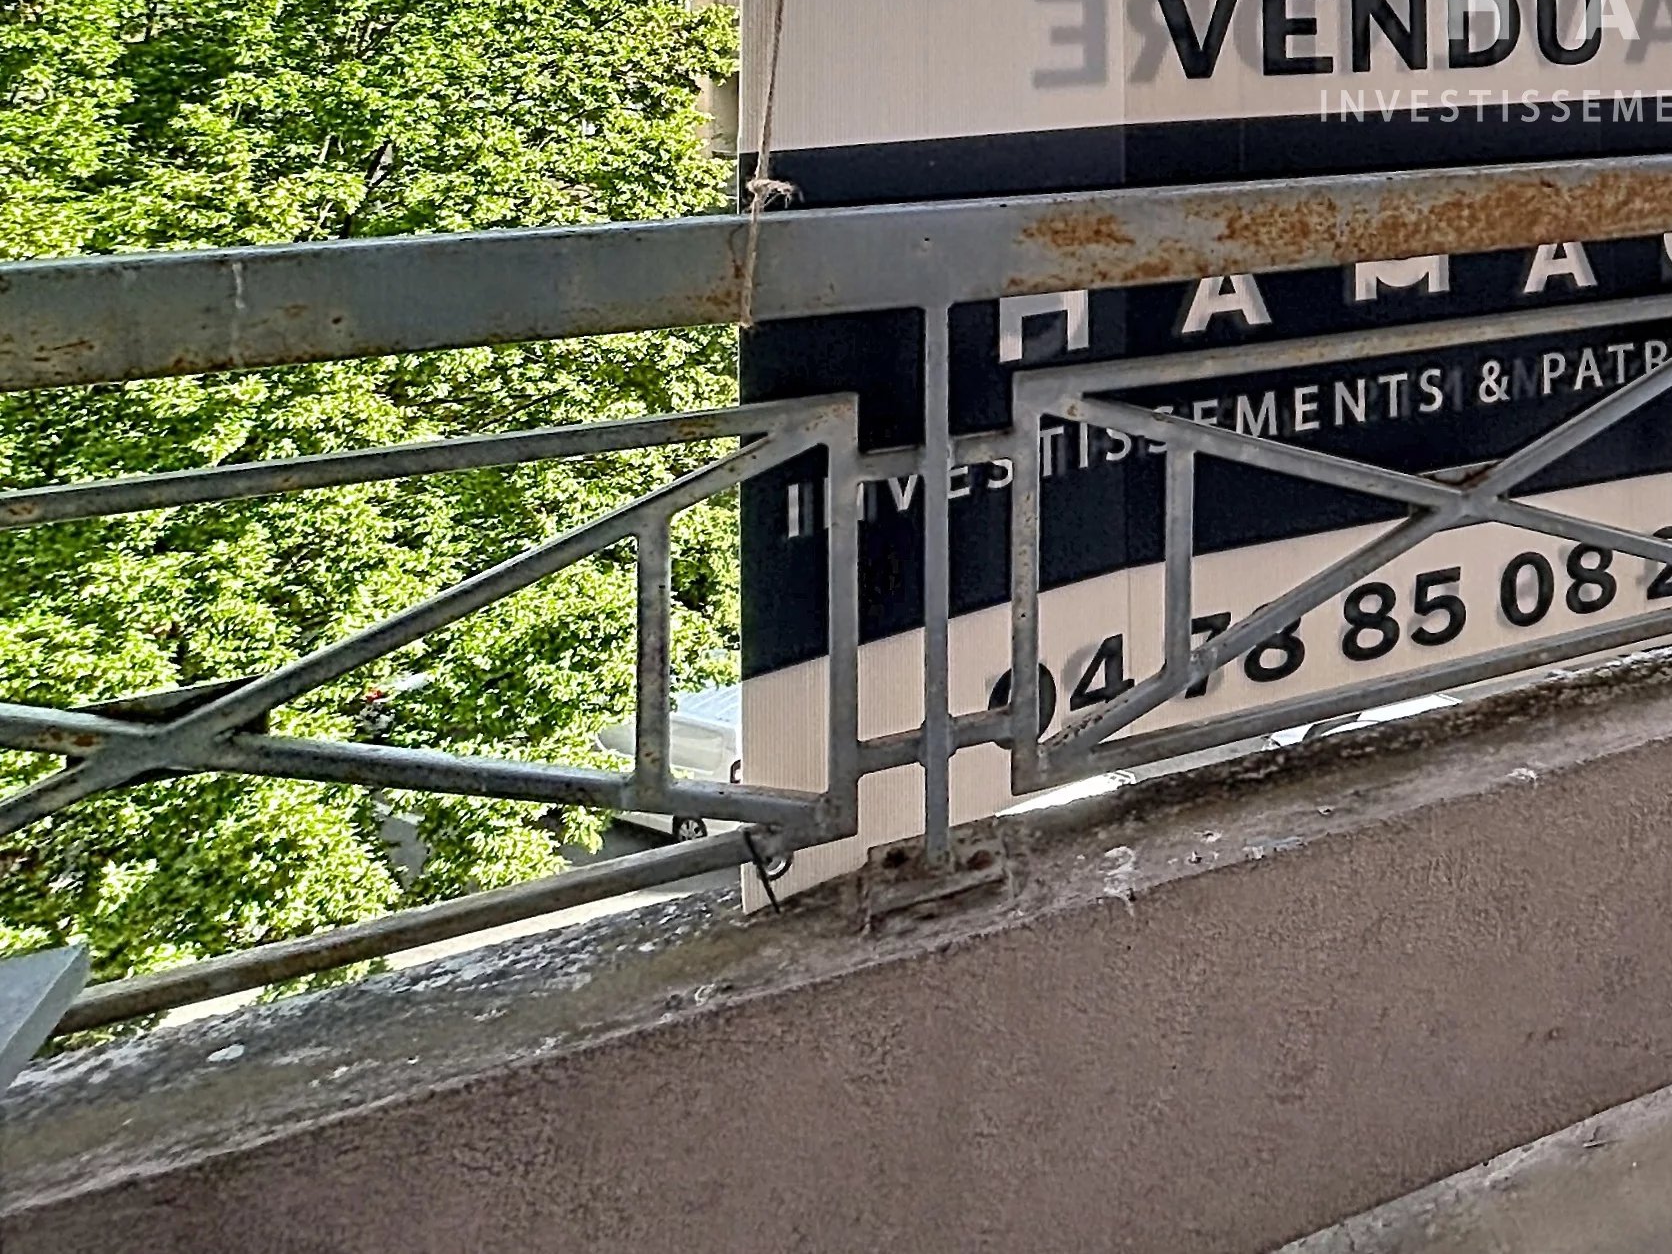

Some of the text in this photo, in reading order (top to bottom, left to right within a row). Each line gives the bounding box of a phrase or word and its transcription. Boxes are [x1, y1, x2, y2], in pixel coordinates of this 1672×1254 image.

[1479, 359, 1511, 404] &
[1341, 566, 1466, 661] 85
[1500, 542, 1617, 627] 08
